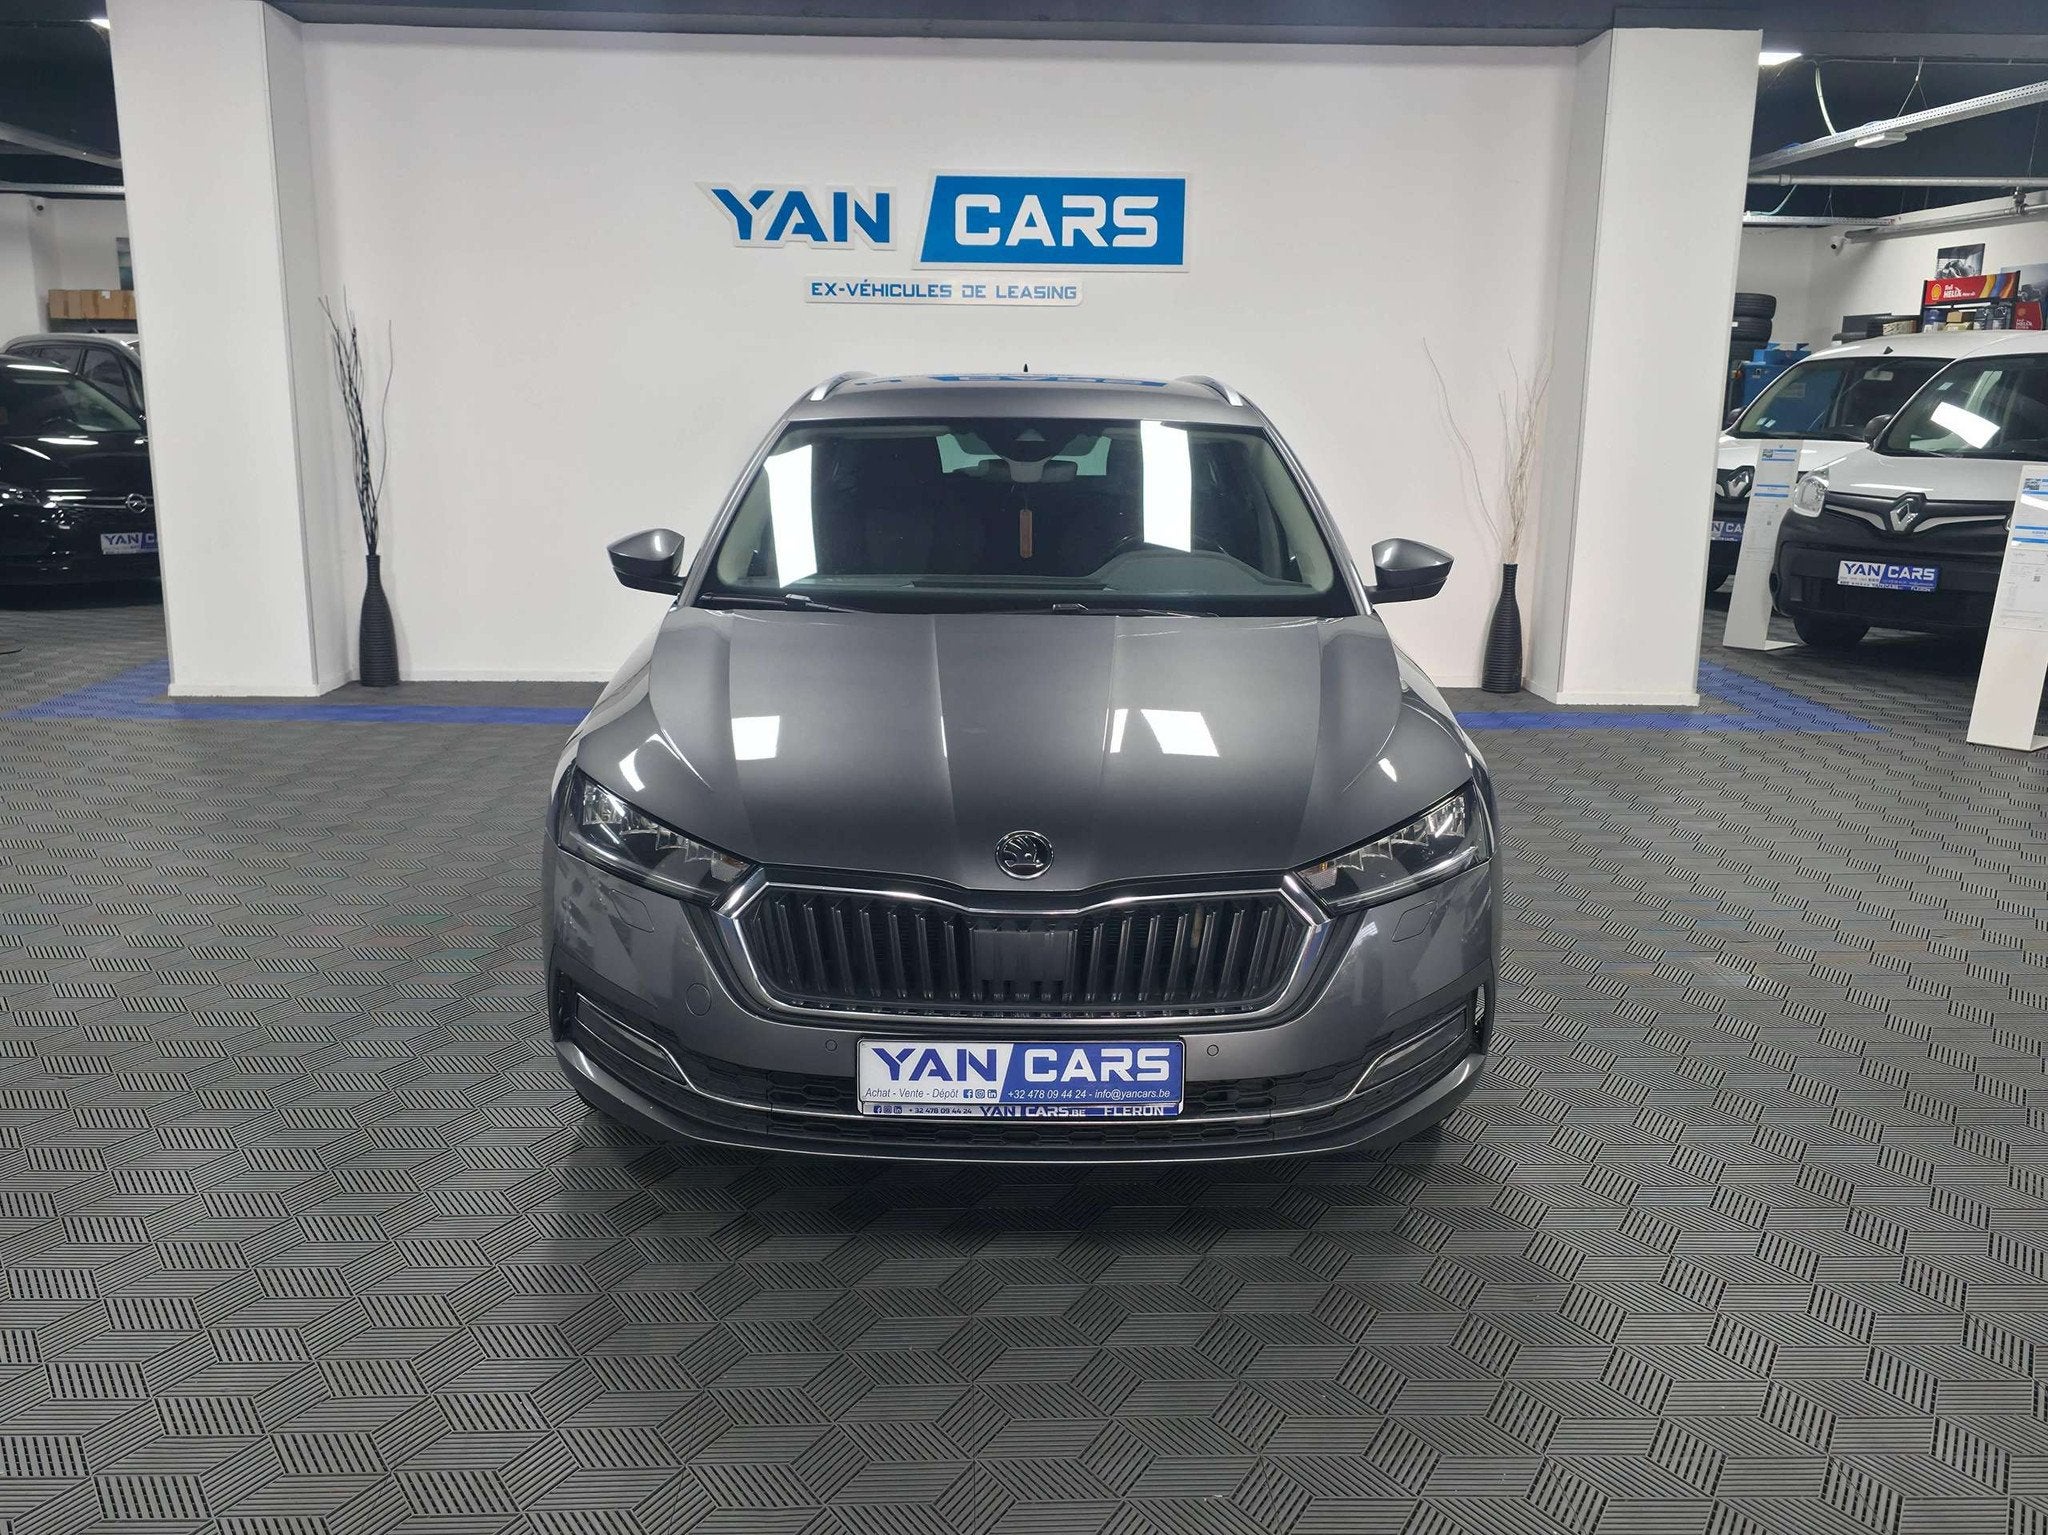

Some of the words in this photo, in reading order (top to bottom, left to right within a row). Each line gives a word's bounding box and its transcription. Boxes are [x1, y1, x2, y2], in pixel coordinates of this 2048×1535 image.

[711, 188, 891, 244] YAN
[954, 193, 1160, 248] CARS
[811, 279, 953, 299] EX-VÉHICULES
[961, 284, 987, 299] DE
[995, 284, 1078, 301] LEASING
[104, 534, 140, 545] YAN
[1844, 562, 1881, 577] YAN
[1887, 565, 1936, 581] CARS
[871, 1047, 998, 1082] YAN
[1024, 1047, 1171, 1082] CARS
[864, 1087, 891, 1099] Achat
[899, 1088, 924, 1099] Vente
[932, 1087, 959, 1101] Dépôt
[1007, 1089, 1026, 1099] +32
[1027, 1089, 1045, 1099] 478
[1047, 1089, 1059, 1099] 09
[1061, 1089, 1073, 1099] 44
[1075, 1089, 1087, 1099] 24
[1094, 1088, 1171, 1100] info@yancars.be
[980, 1106, 1015, 1117] YAN
[1104, 1105, 1165, 1116] FLERON
